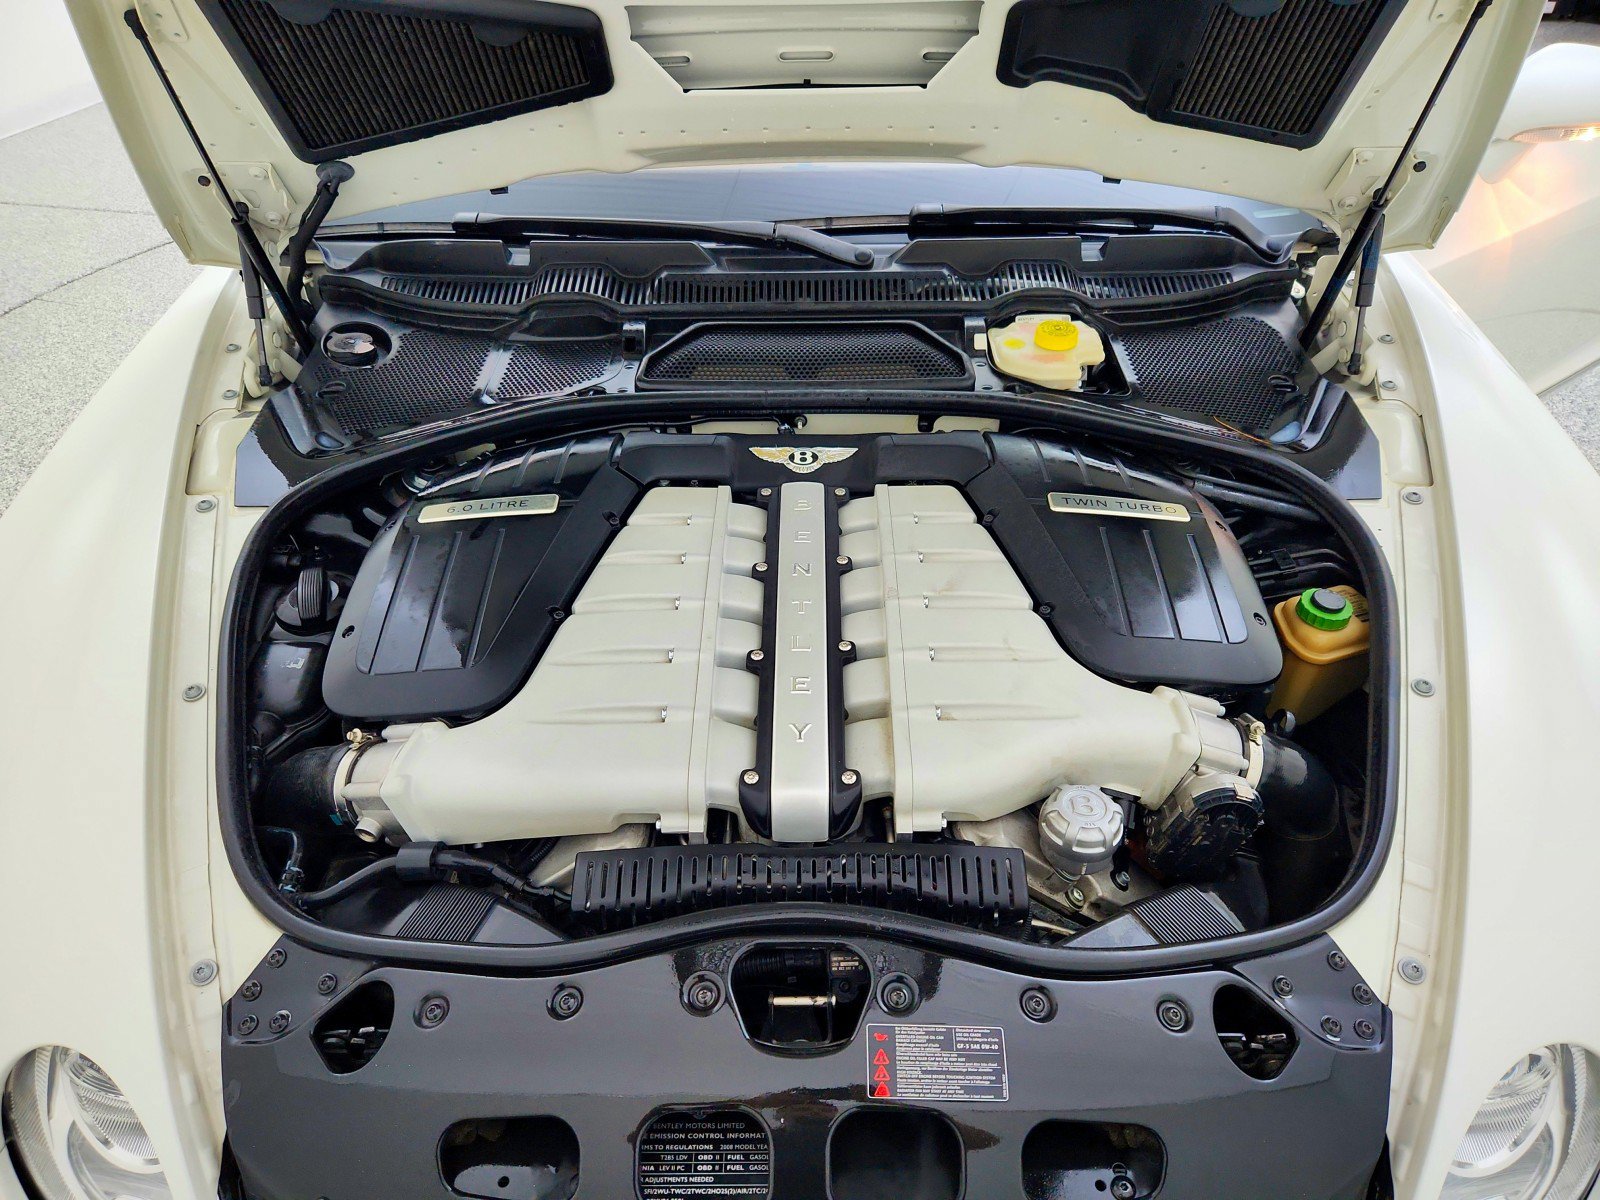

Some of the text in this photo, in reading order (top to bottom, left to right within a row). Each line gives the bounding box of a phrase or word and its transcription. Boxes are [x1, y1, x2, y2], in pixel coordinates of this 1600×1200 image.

[446, 500, 530, 513] 6.0 LITRE
[1060, 497, 1177, 513] TWIN TURBO
[788, 499, 812, 742] BENTLEY
